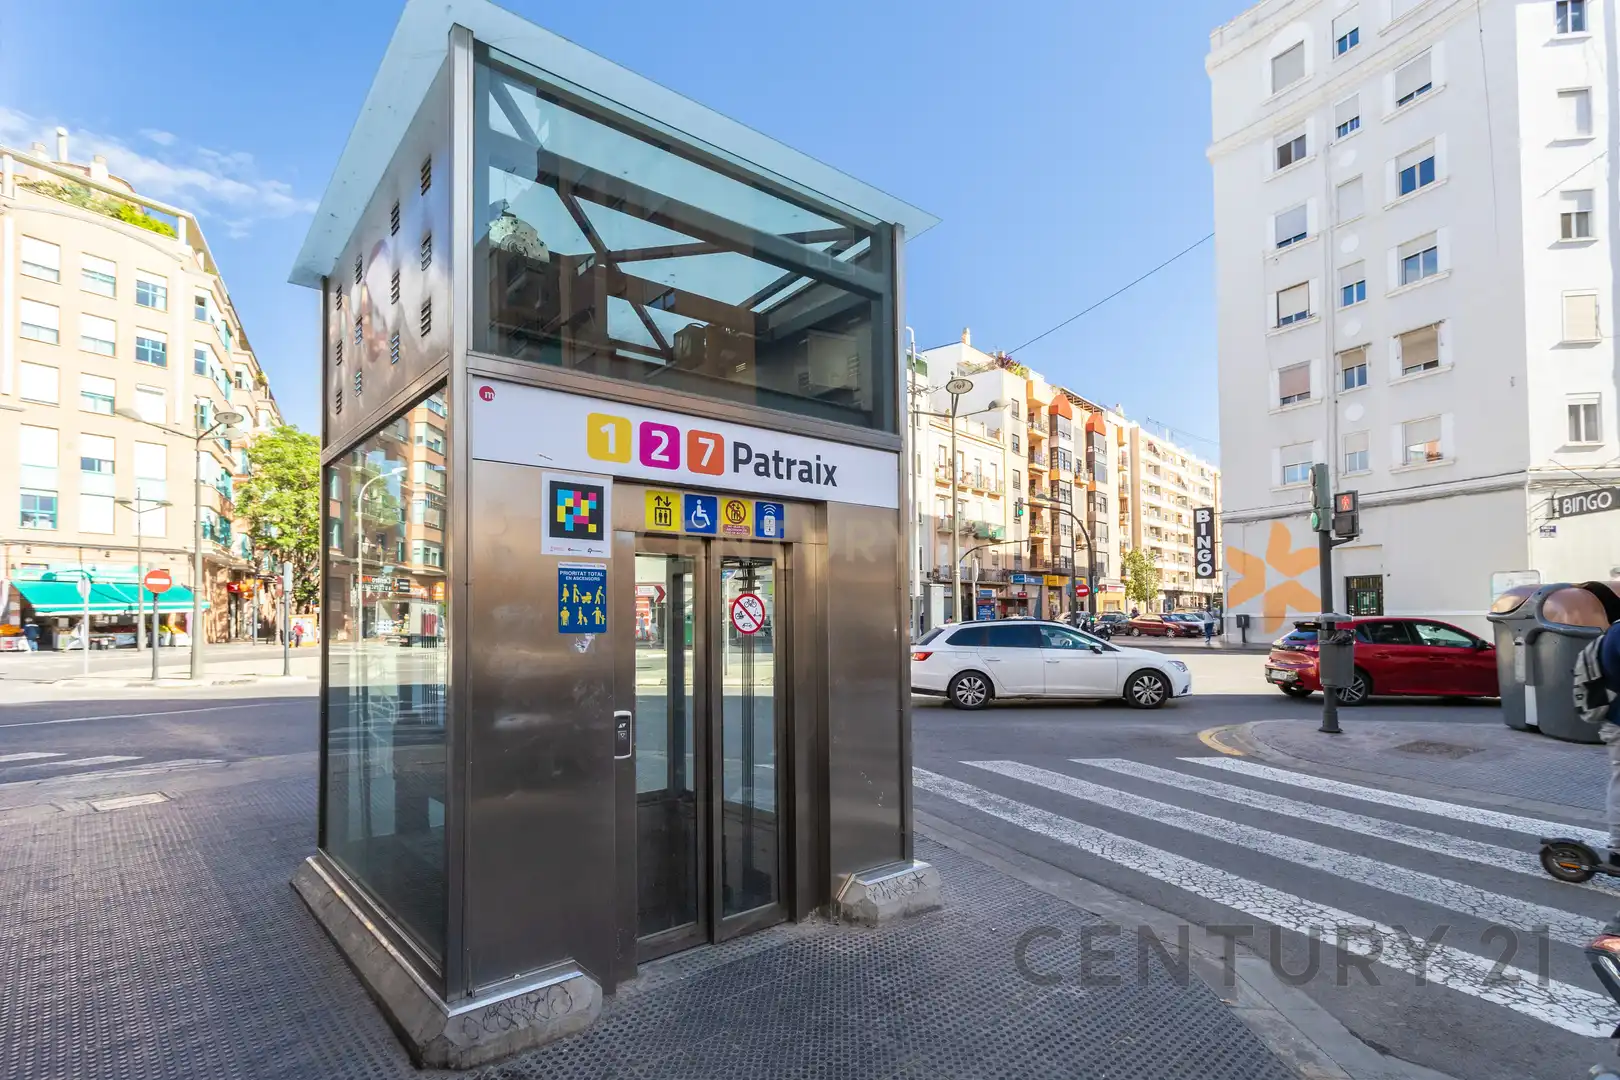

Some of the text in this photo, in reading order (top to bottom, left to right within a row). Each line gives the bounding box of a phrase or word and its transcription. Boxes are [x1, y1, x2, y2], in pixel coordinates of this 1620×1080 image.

[600, 423, 838, 487] 1 2 7 Patraix
[1562, 491, 1612, 515] BINGO
[1196, 510, 1213, 577] BINGO
